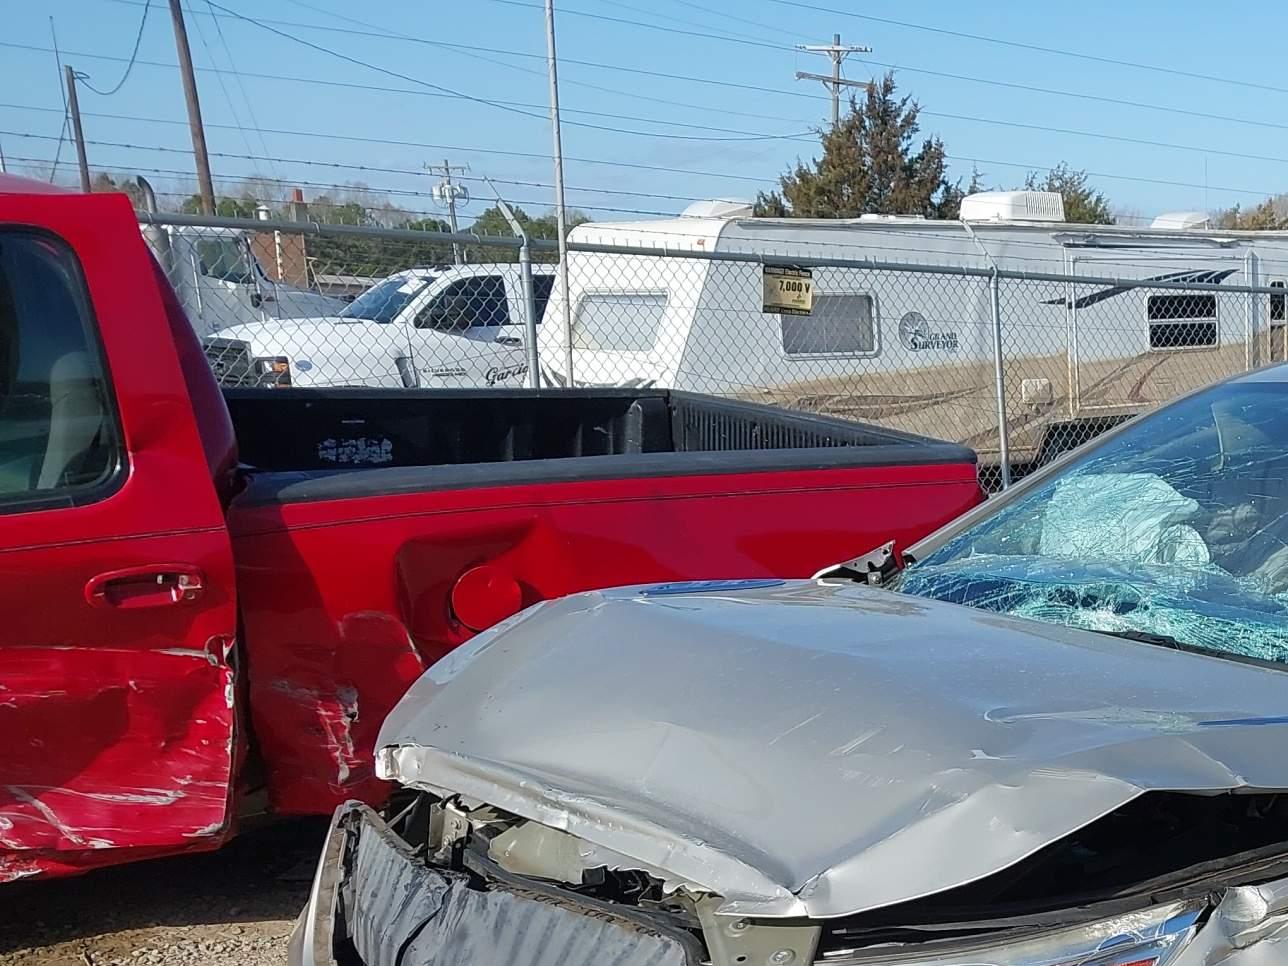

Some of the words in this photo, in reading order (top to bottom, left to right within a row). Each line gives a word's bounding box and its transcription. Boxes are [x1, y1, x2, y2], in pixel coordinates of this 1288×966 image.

[779, 280, 803, 293] 7,000
[804, 283, 811, 294] V
[910, 336, 959, 350] SURVEYOR
